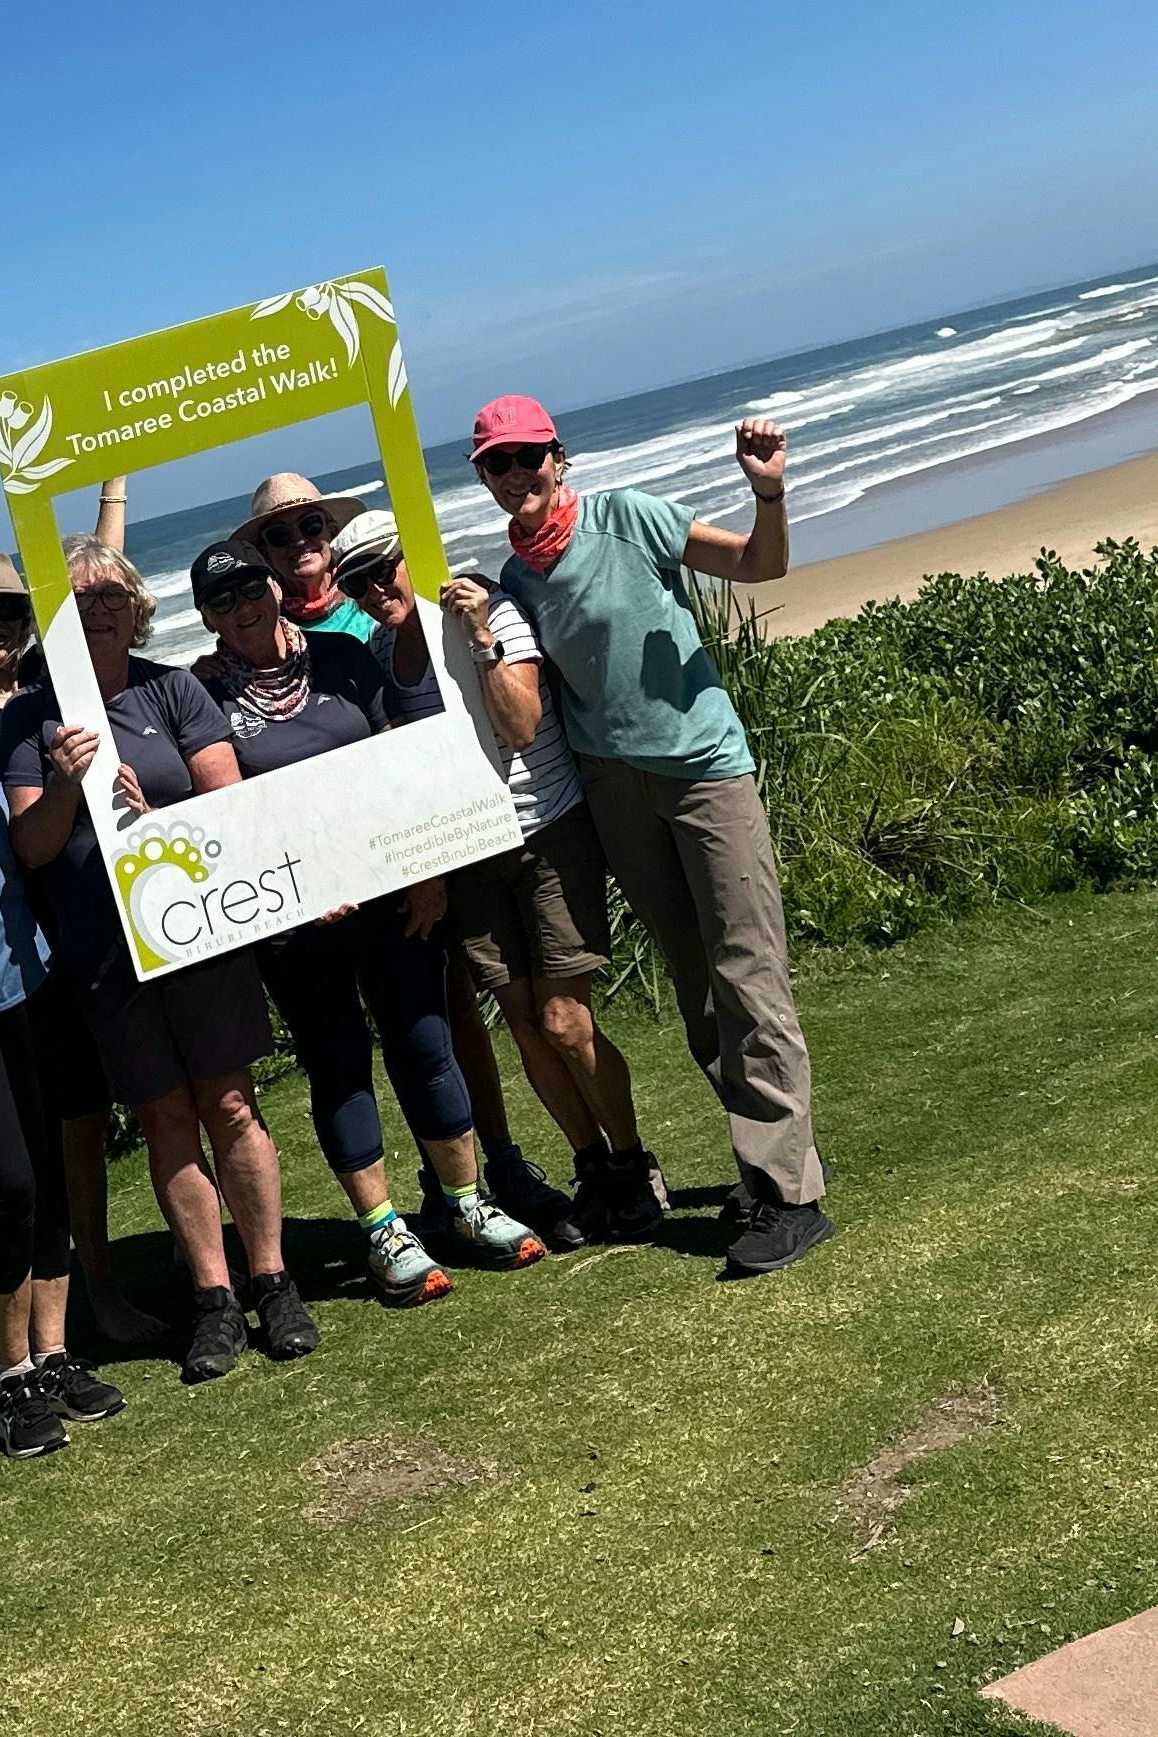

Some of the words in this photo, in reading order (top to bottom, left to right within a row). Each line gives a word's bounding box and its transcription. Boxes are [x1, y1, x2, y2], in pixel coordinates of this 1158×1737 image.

[65, 413, 173, 456] Tomaree
[178, 377, 267, 422] Coastal
[270, 357, 339, 395] Walk!
[103, 390, 113, 412] I
[118, 349, 247, 407] completed
[251, 343, 291, 367] the
[368, 792, 507, 850] #TomareeCoastalWalk
[384, 812, 512, 865] #IncredibleByNature
[401, 829, 517, 877] #CrestBirubiBeach
[161, 851, 302, 946] crest
[253, 907, 305, 934] BEACH
